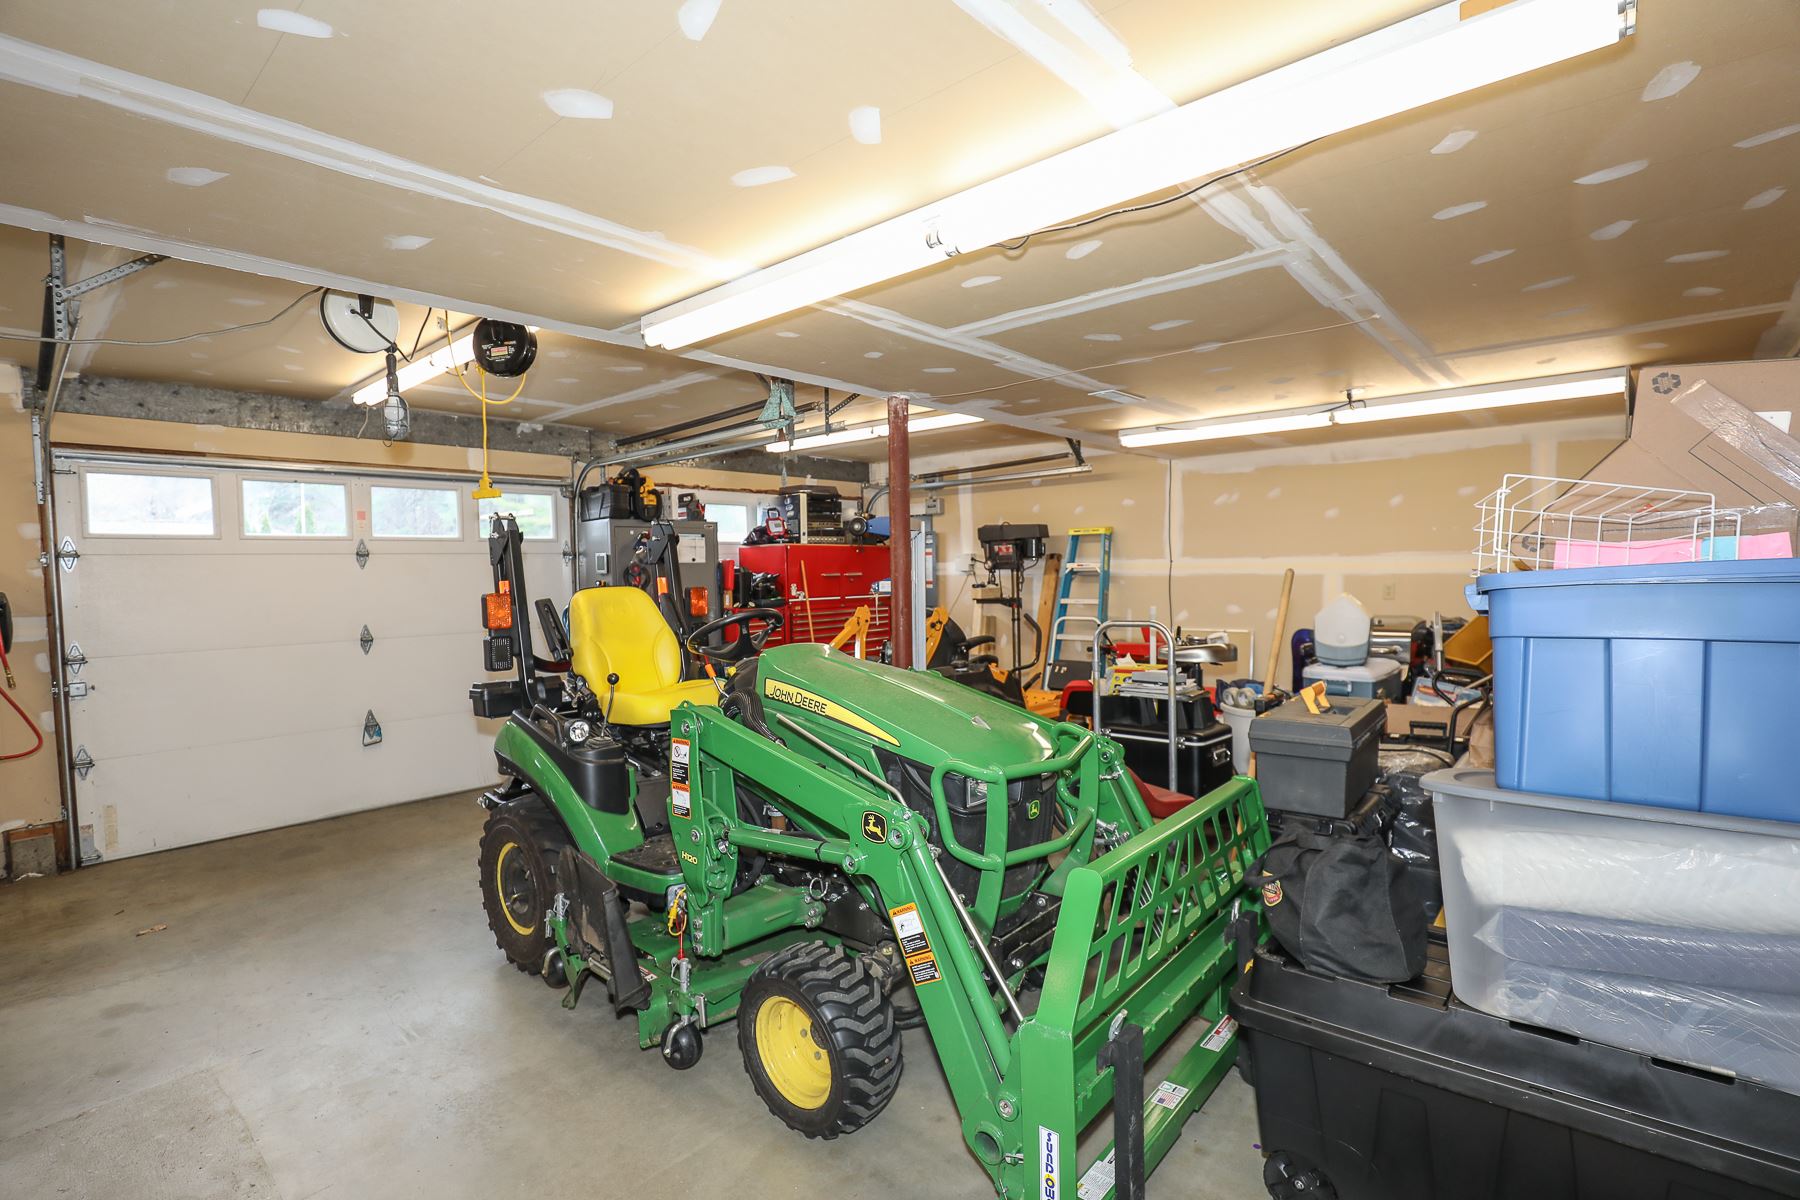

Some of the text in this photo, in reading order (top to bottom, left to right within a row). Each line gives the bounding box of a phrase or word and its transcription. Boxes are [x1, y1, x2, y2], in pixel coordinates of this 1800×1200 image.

[769, 685, 827, 714] JOHN DEERE
[1044, 1132, 1056, 1200] SUNDOW
